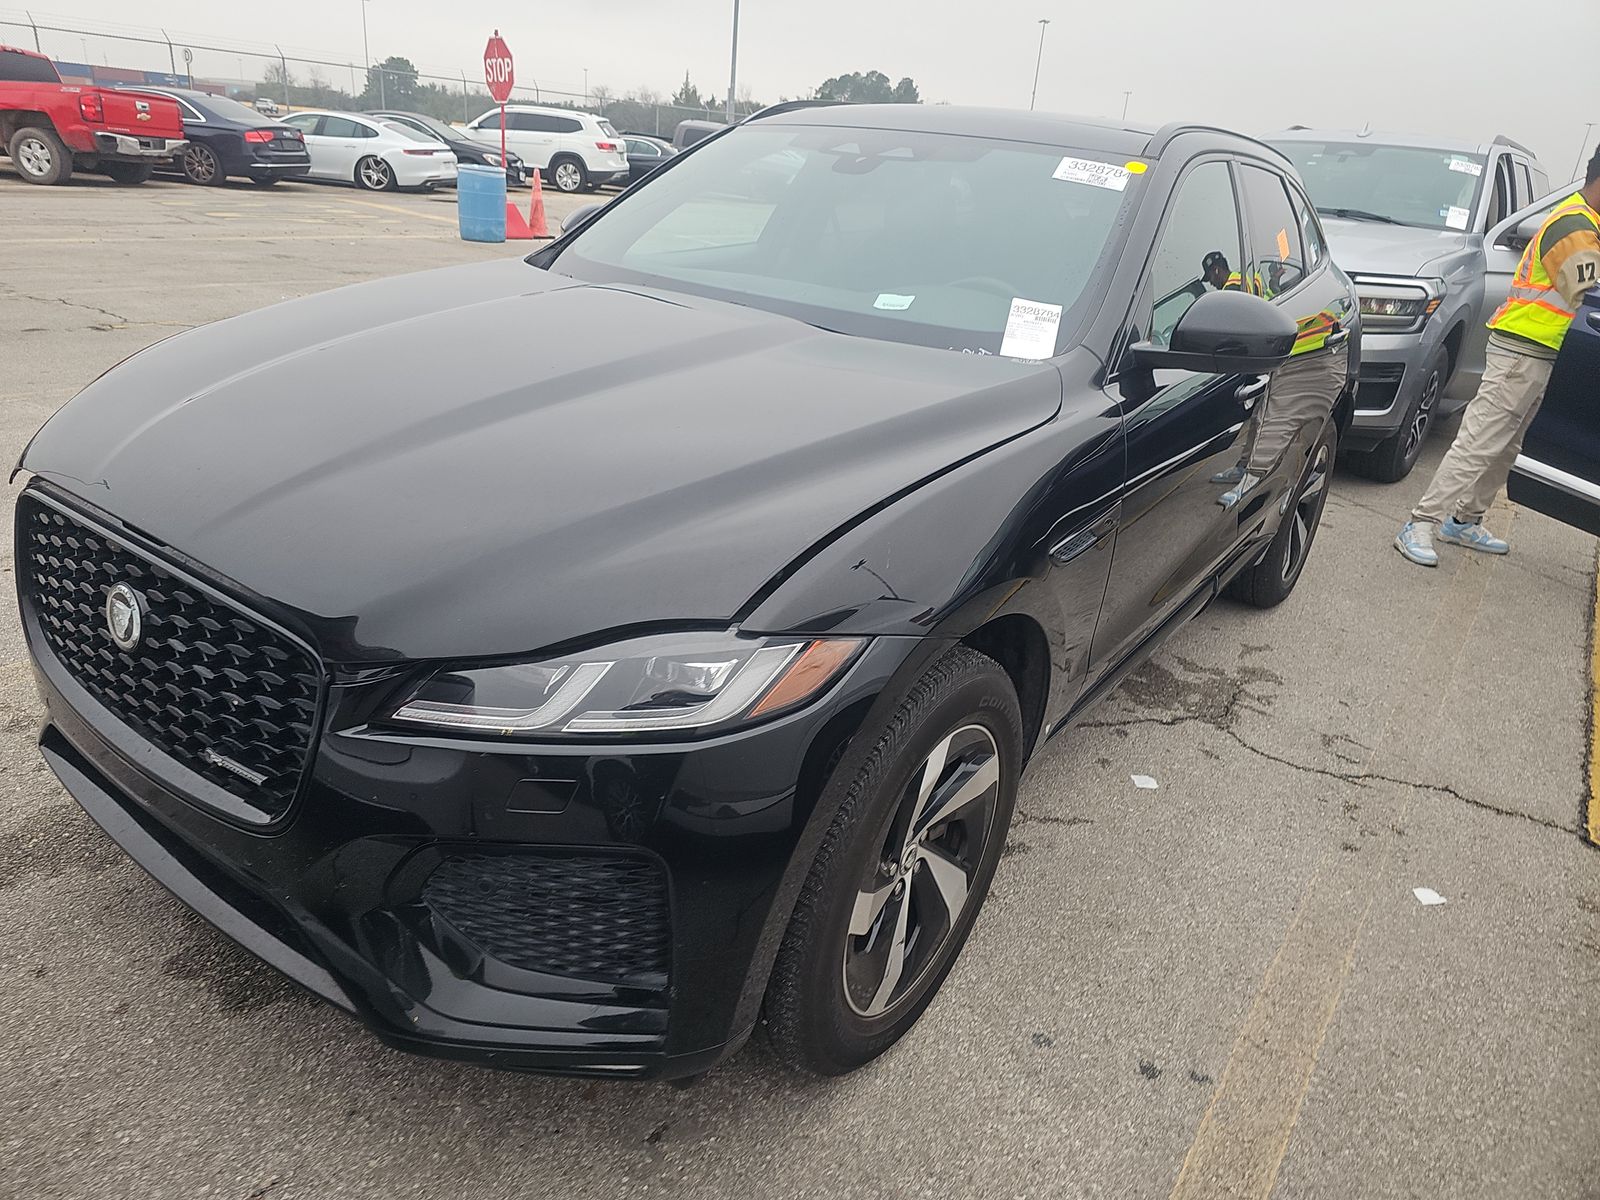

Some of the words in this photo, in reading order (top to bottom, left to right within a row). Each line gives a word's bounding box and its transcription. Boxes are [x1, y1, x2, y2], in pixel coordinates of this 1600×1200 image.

[486, 57, 512, 83] STOP
[1068, 160, 1131, 179] 3328784
[1576, 262, 1596, 283] 17
